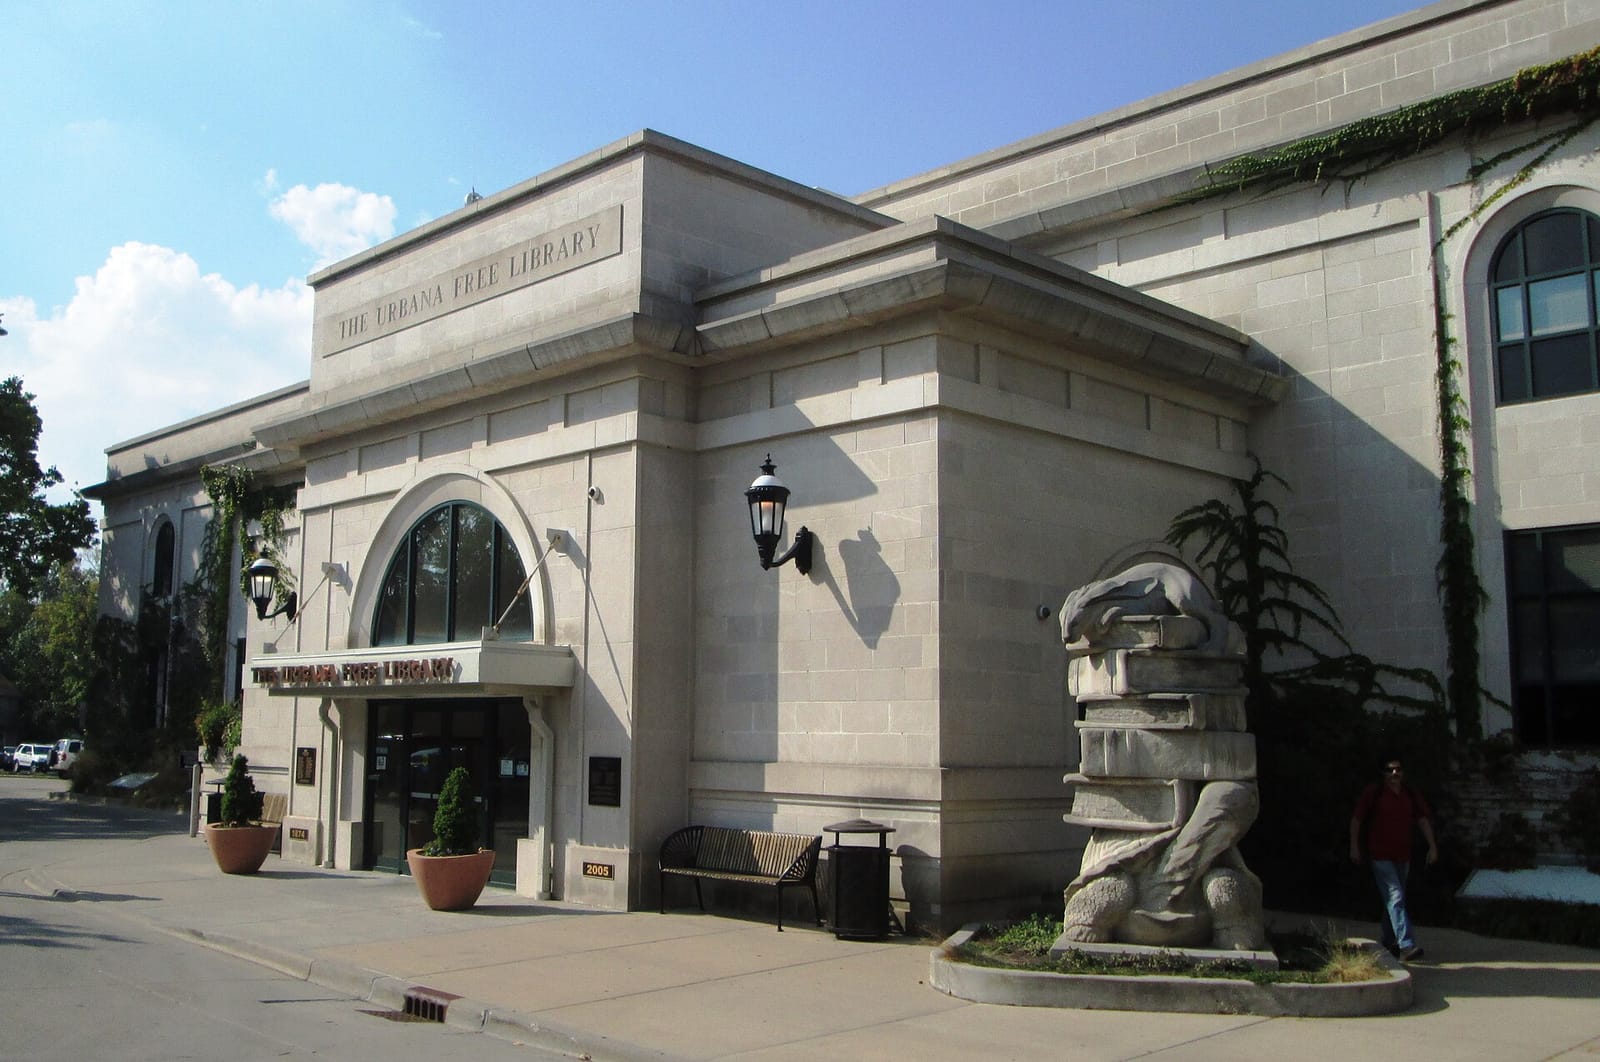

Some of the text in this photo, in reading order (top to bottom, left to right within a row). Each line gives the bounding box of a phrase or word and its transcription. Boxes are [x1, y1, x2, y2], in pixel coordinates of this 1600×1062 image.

[339, 223, 600, 339] THE URBANA FREE LIBRARY
[586, 864, 609, 876] 2005
